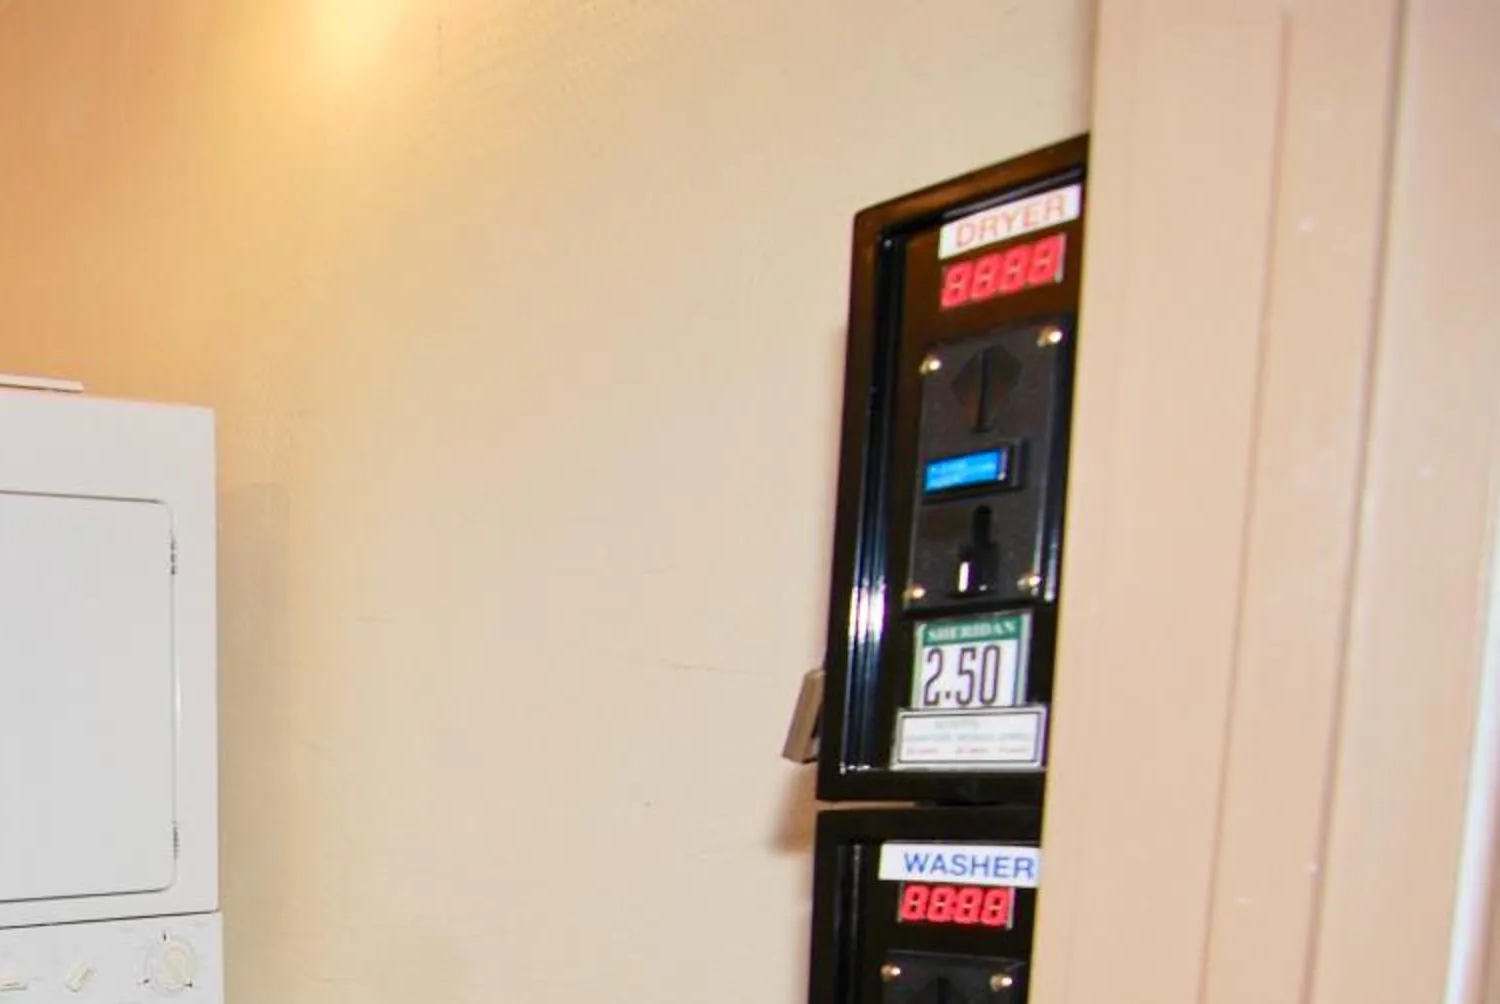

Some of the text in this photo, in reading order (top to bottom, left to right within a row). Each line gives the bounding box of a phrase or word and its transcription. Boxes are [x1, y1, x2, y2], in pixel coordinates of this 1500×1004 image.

[956, 194, 1065, 247] DRYER
[923, 644, 1001, 707] 2.50
[903, 852, 1036, 881] WASHER
